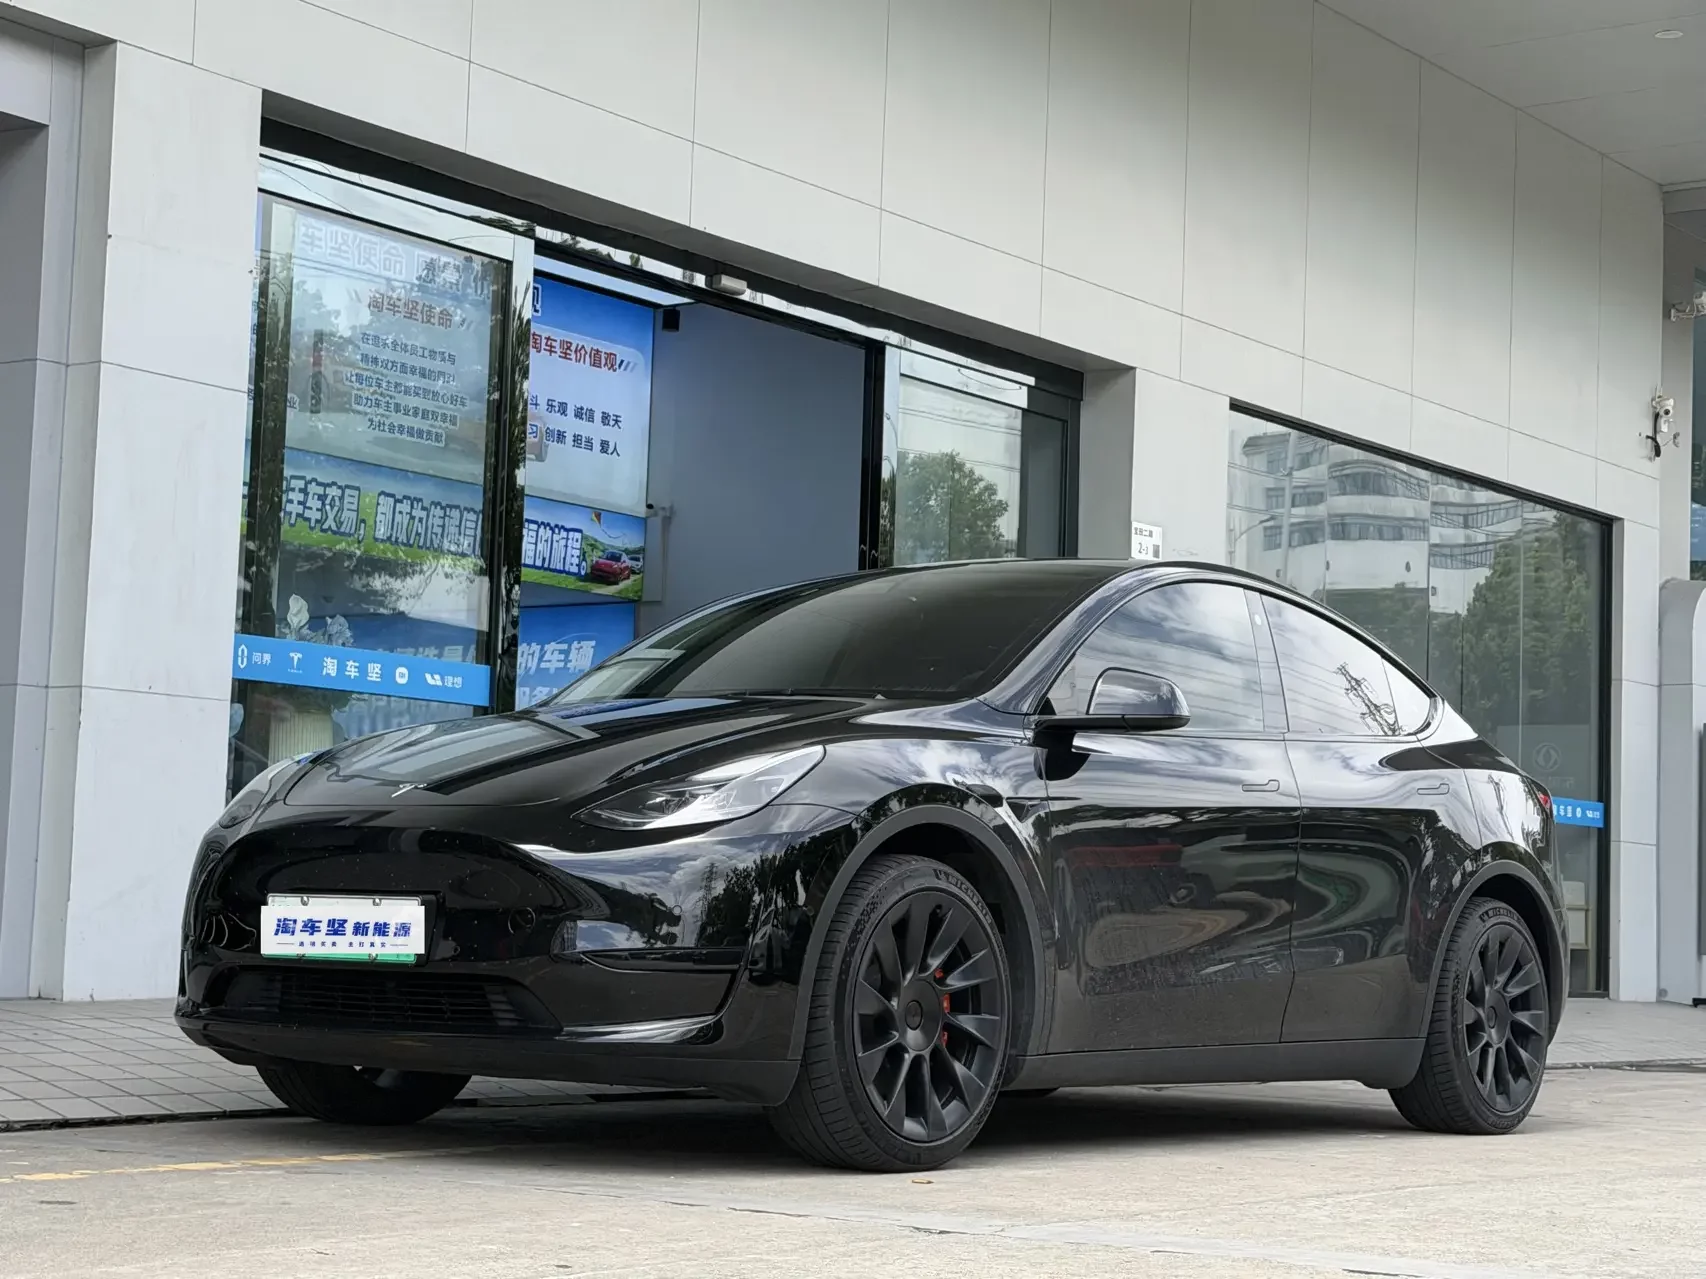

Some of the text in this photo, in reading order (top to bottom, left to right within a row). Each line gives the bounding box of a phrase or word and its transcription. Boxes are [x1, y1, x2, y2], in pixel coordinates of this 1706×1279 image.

[546, 398, 568, 417] 乐观
[573, 404, 595, 424] 诚信
[601, 411, 622, 429] 敬天
[545, 427, 567, 445] 创新
[572, 432, 594, 452] 担当
[600, 439, 621, 457] 爱人
[252, 652, 271, 666] 问界
[322, 657, 382, 682] 淘车坚
